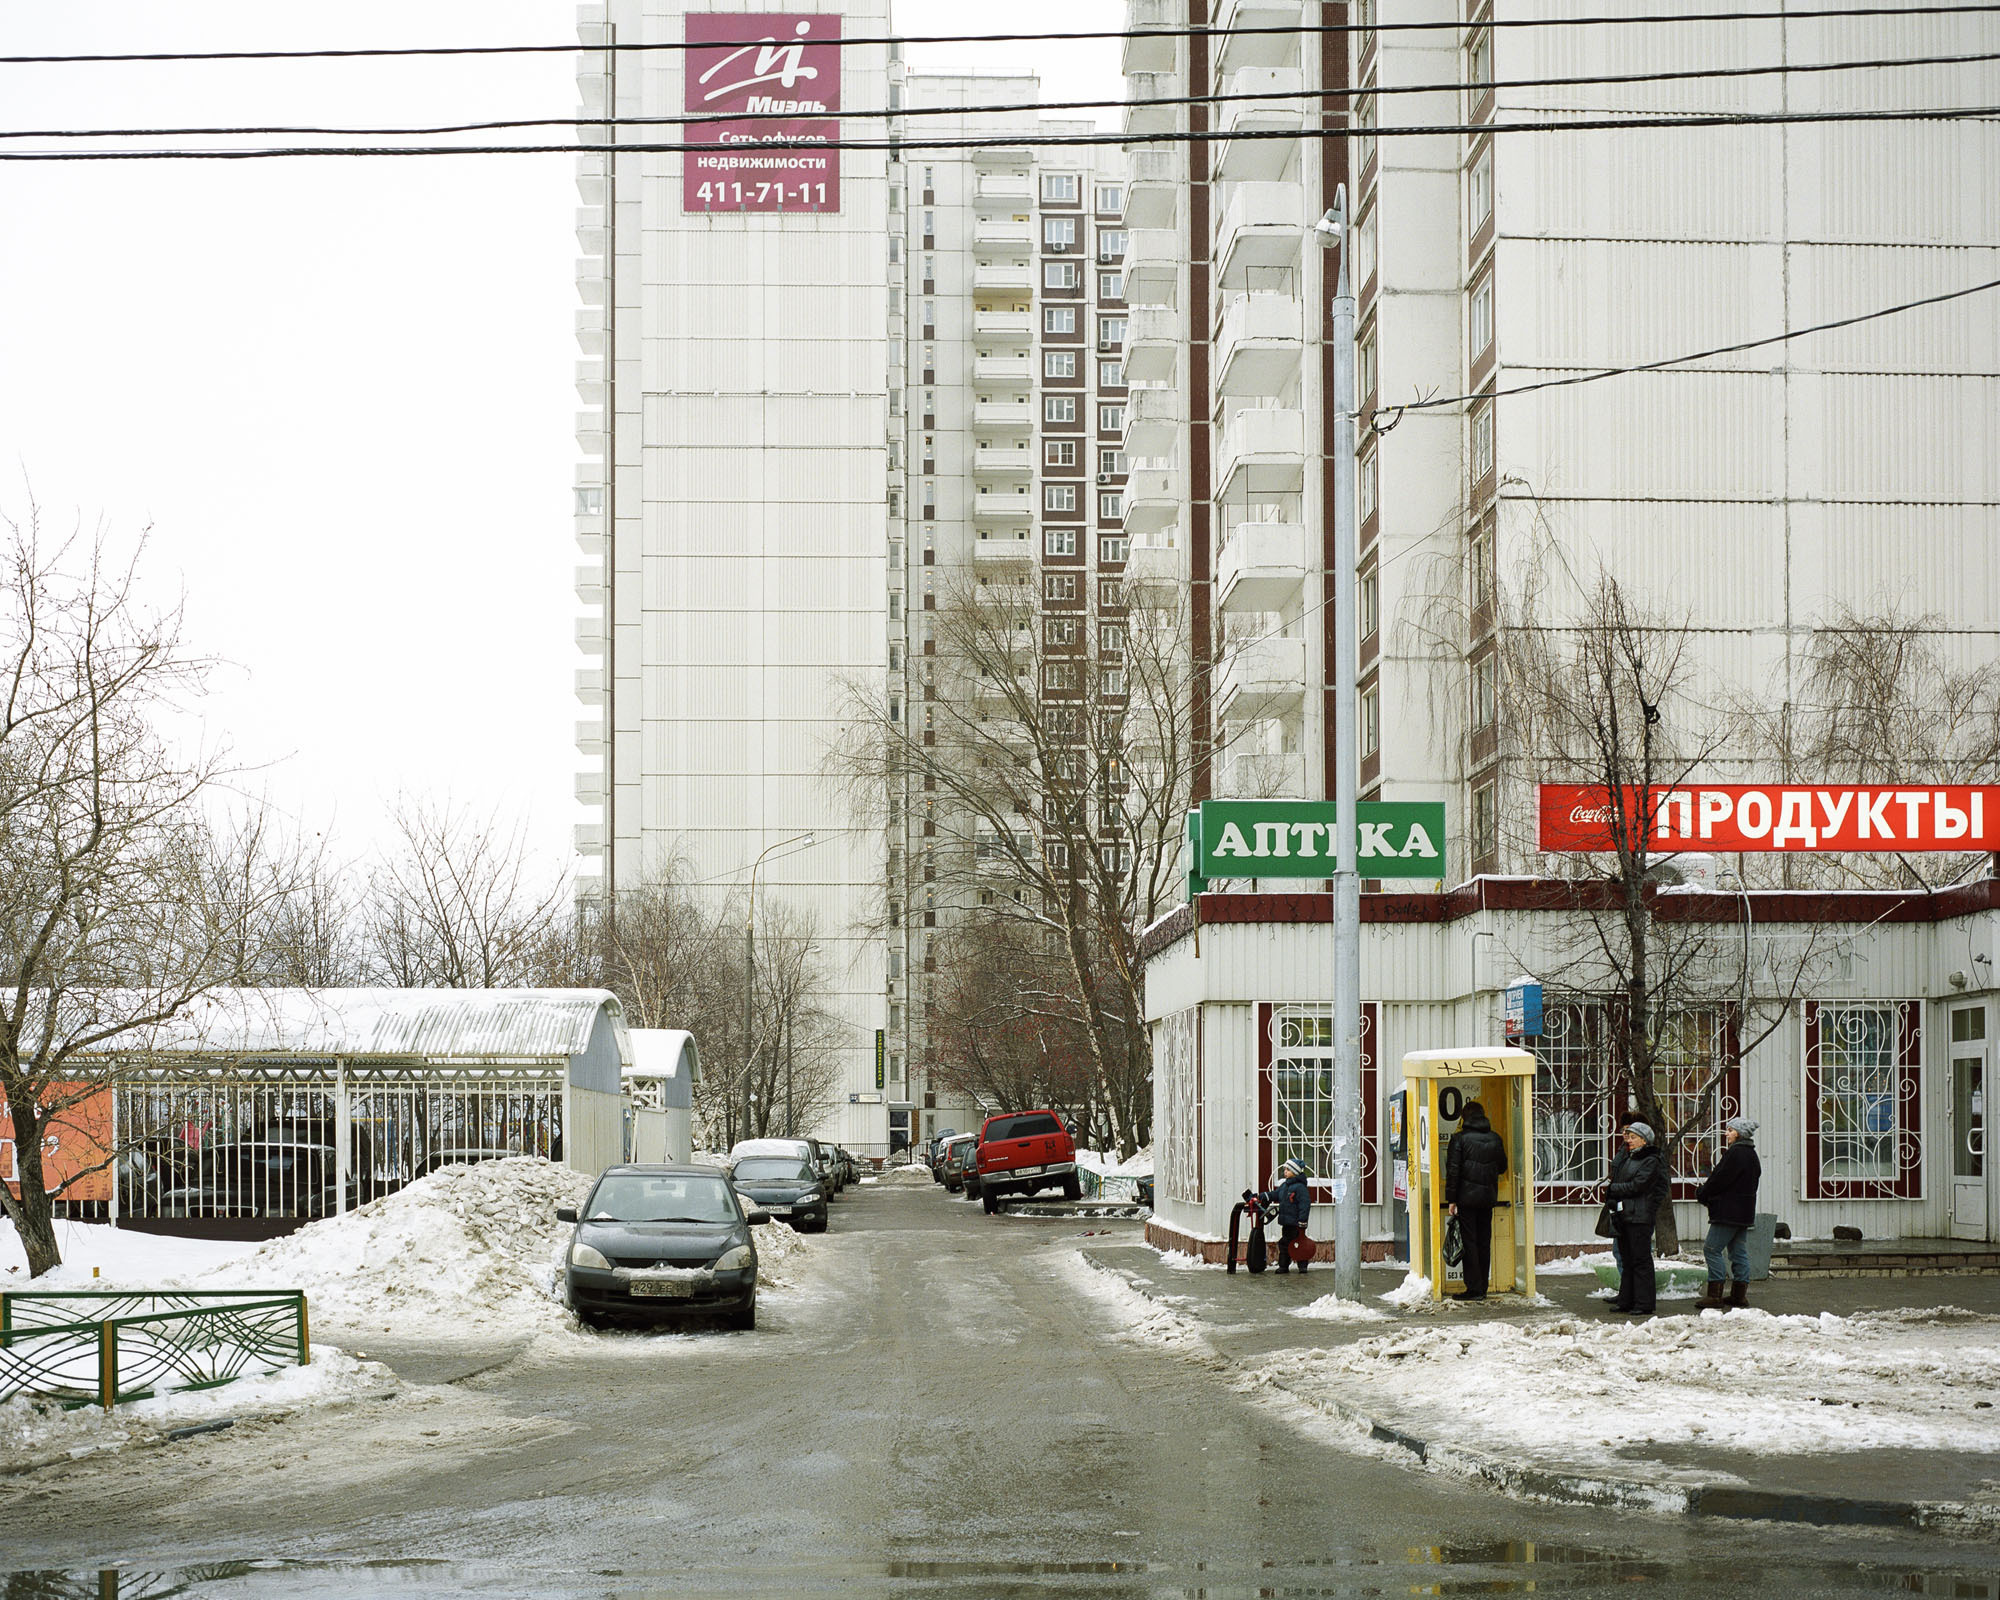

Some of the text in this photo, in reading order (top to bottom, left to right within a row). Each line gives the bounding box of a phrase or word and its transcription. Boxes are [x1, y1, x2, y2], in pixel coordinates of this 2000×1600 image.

[746, 96, 827, 113] Миэль
[719, 131, 827, 144] Сеть офисов
[697, 157, 826, 171] недвижимости
[696, 181, 826, 204] 411-71-11
[1656, 790, 1984, 848] ПРОДУКТЫ
